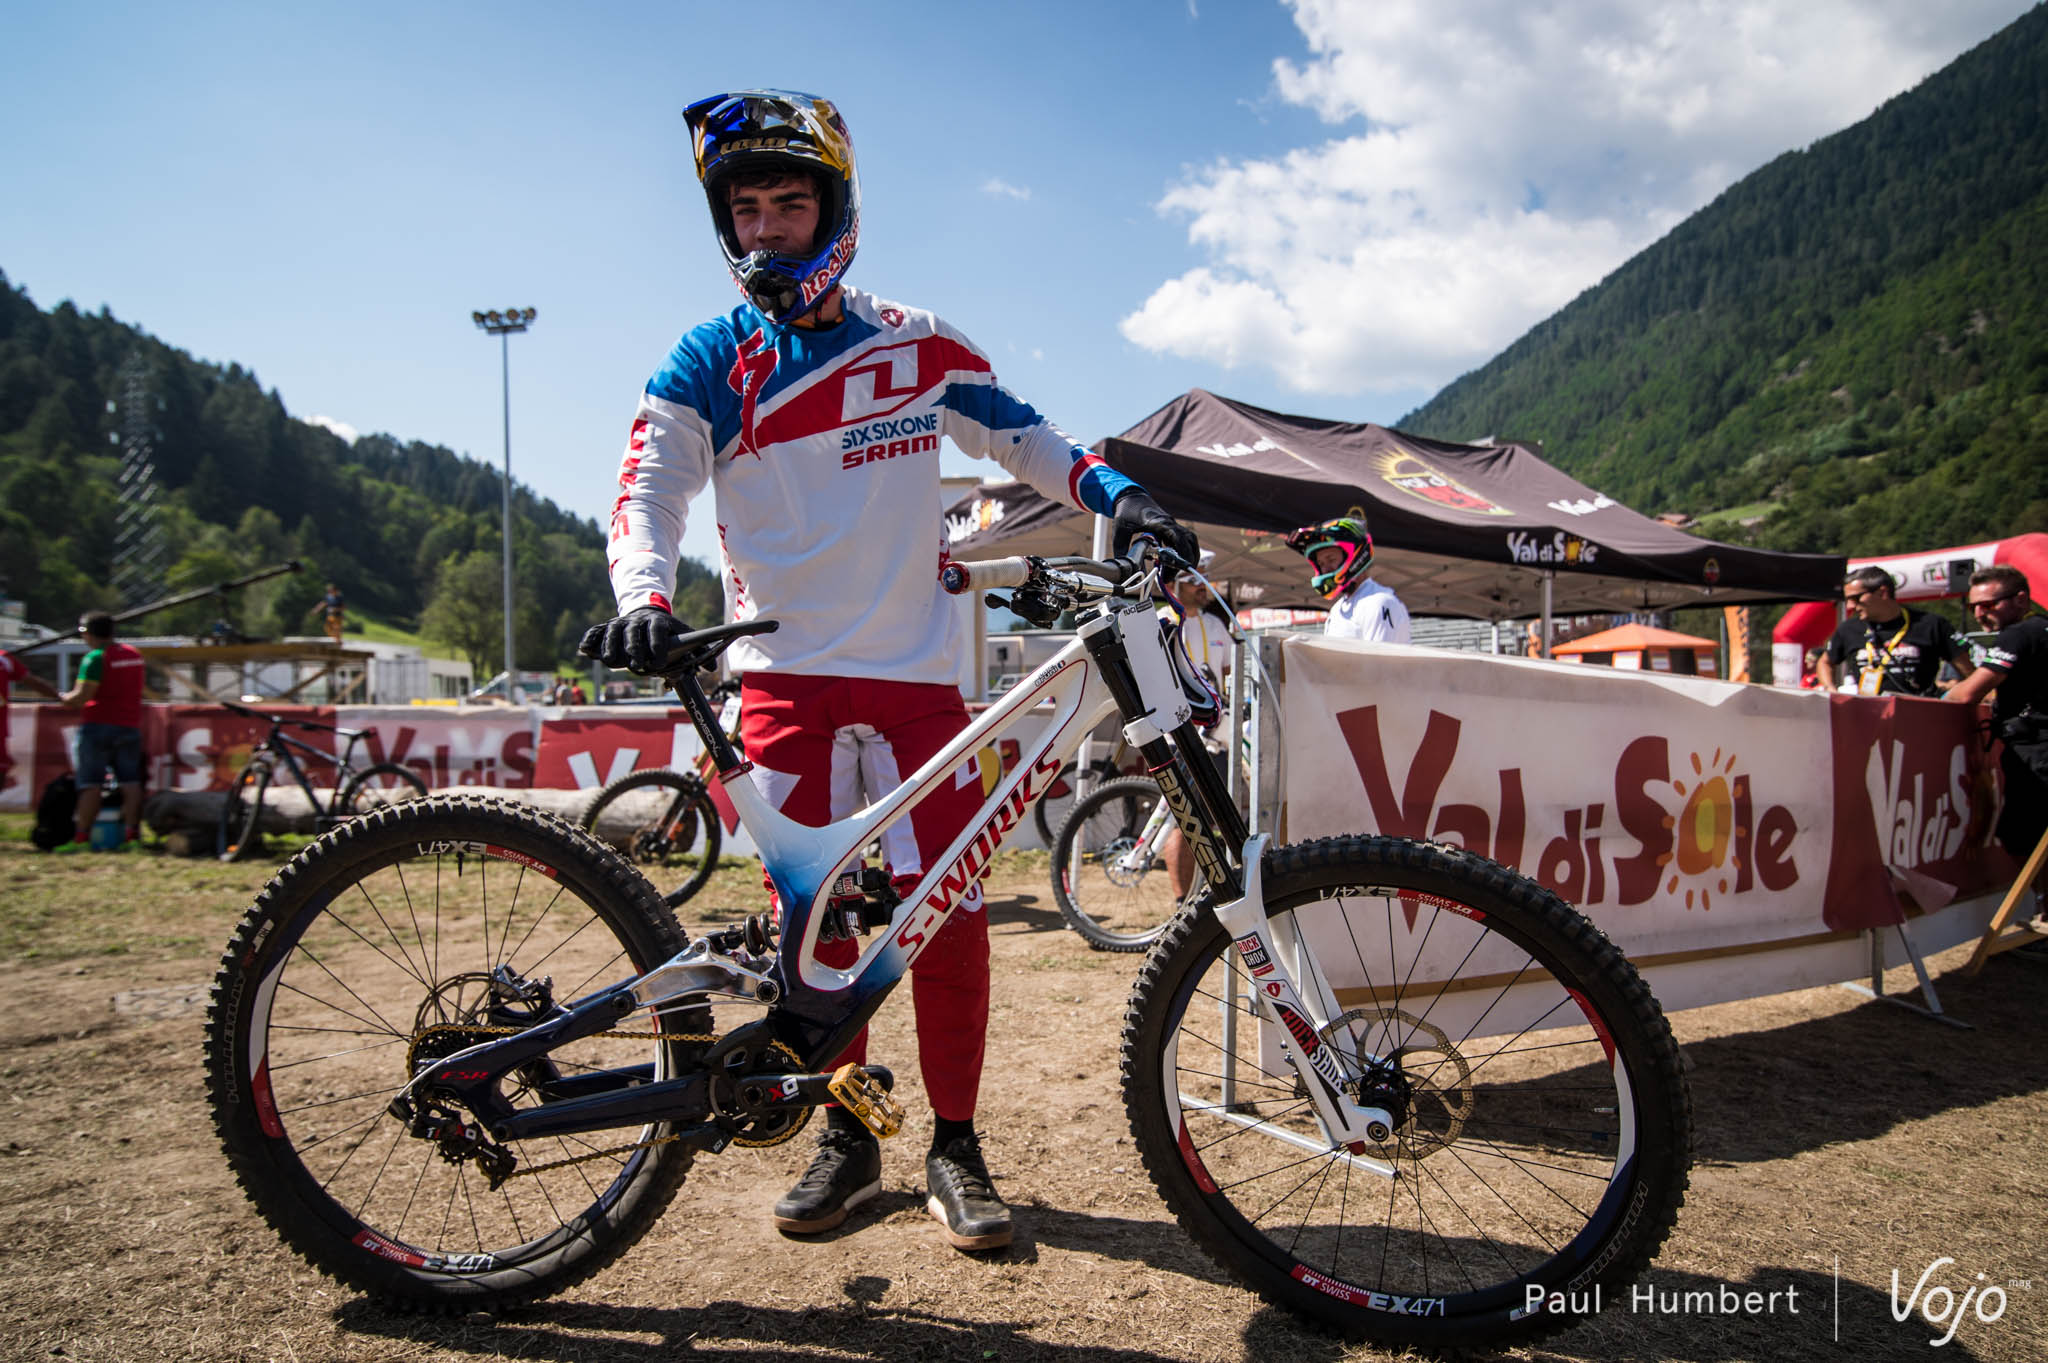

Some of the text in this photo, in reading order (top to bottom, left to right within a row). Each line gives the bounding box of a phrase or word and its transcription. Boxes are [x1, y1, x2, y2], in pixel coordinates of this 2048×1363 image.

[801, 244, 841, 306] Red
[841, 413, 937, 449] SIXSIXONE
[842, 434, 937, 470] SRAM
[1507, 532, 1598, 565] Val di Sole
[689, 699, 720, 750] THOMSON
[1336, 705, 1799, 934] Val di Sole
[1866, 739, 1922, 869] Val
[1922, 792, 1949, 863] di
[1154, 769, 1226, 887] BOXXER
[417, 840, 547, 872] DT SWISS EX471
[898, 755, 1061, 948] S-WORKS
[1320, 886, 1473, 915] DT SWISS EX471
[1238, 937, 1261, 954] ROCK
[1244, 950, 1267, 968] SHOX
[1282, 1009, 1347, 1093] ROCK SHOX
[440, 1070, 490, 1081] FSR
[362, 1239, 495, 1272] DT SWISS EX471
[1301, 1273, 1445, 1317] DT SWISS EX471
